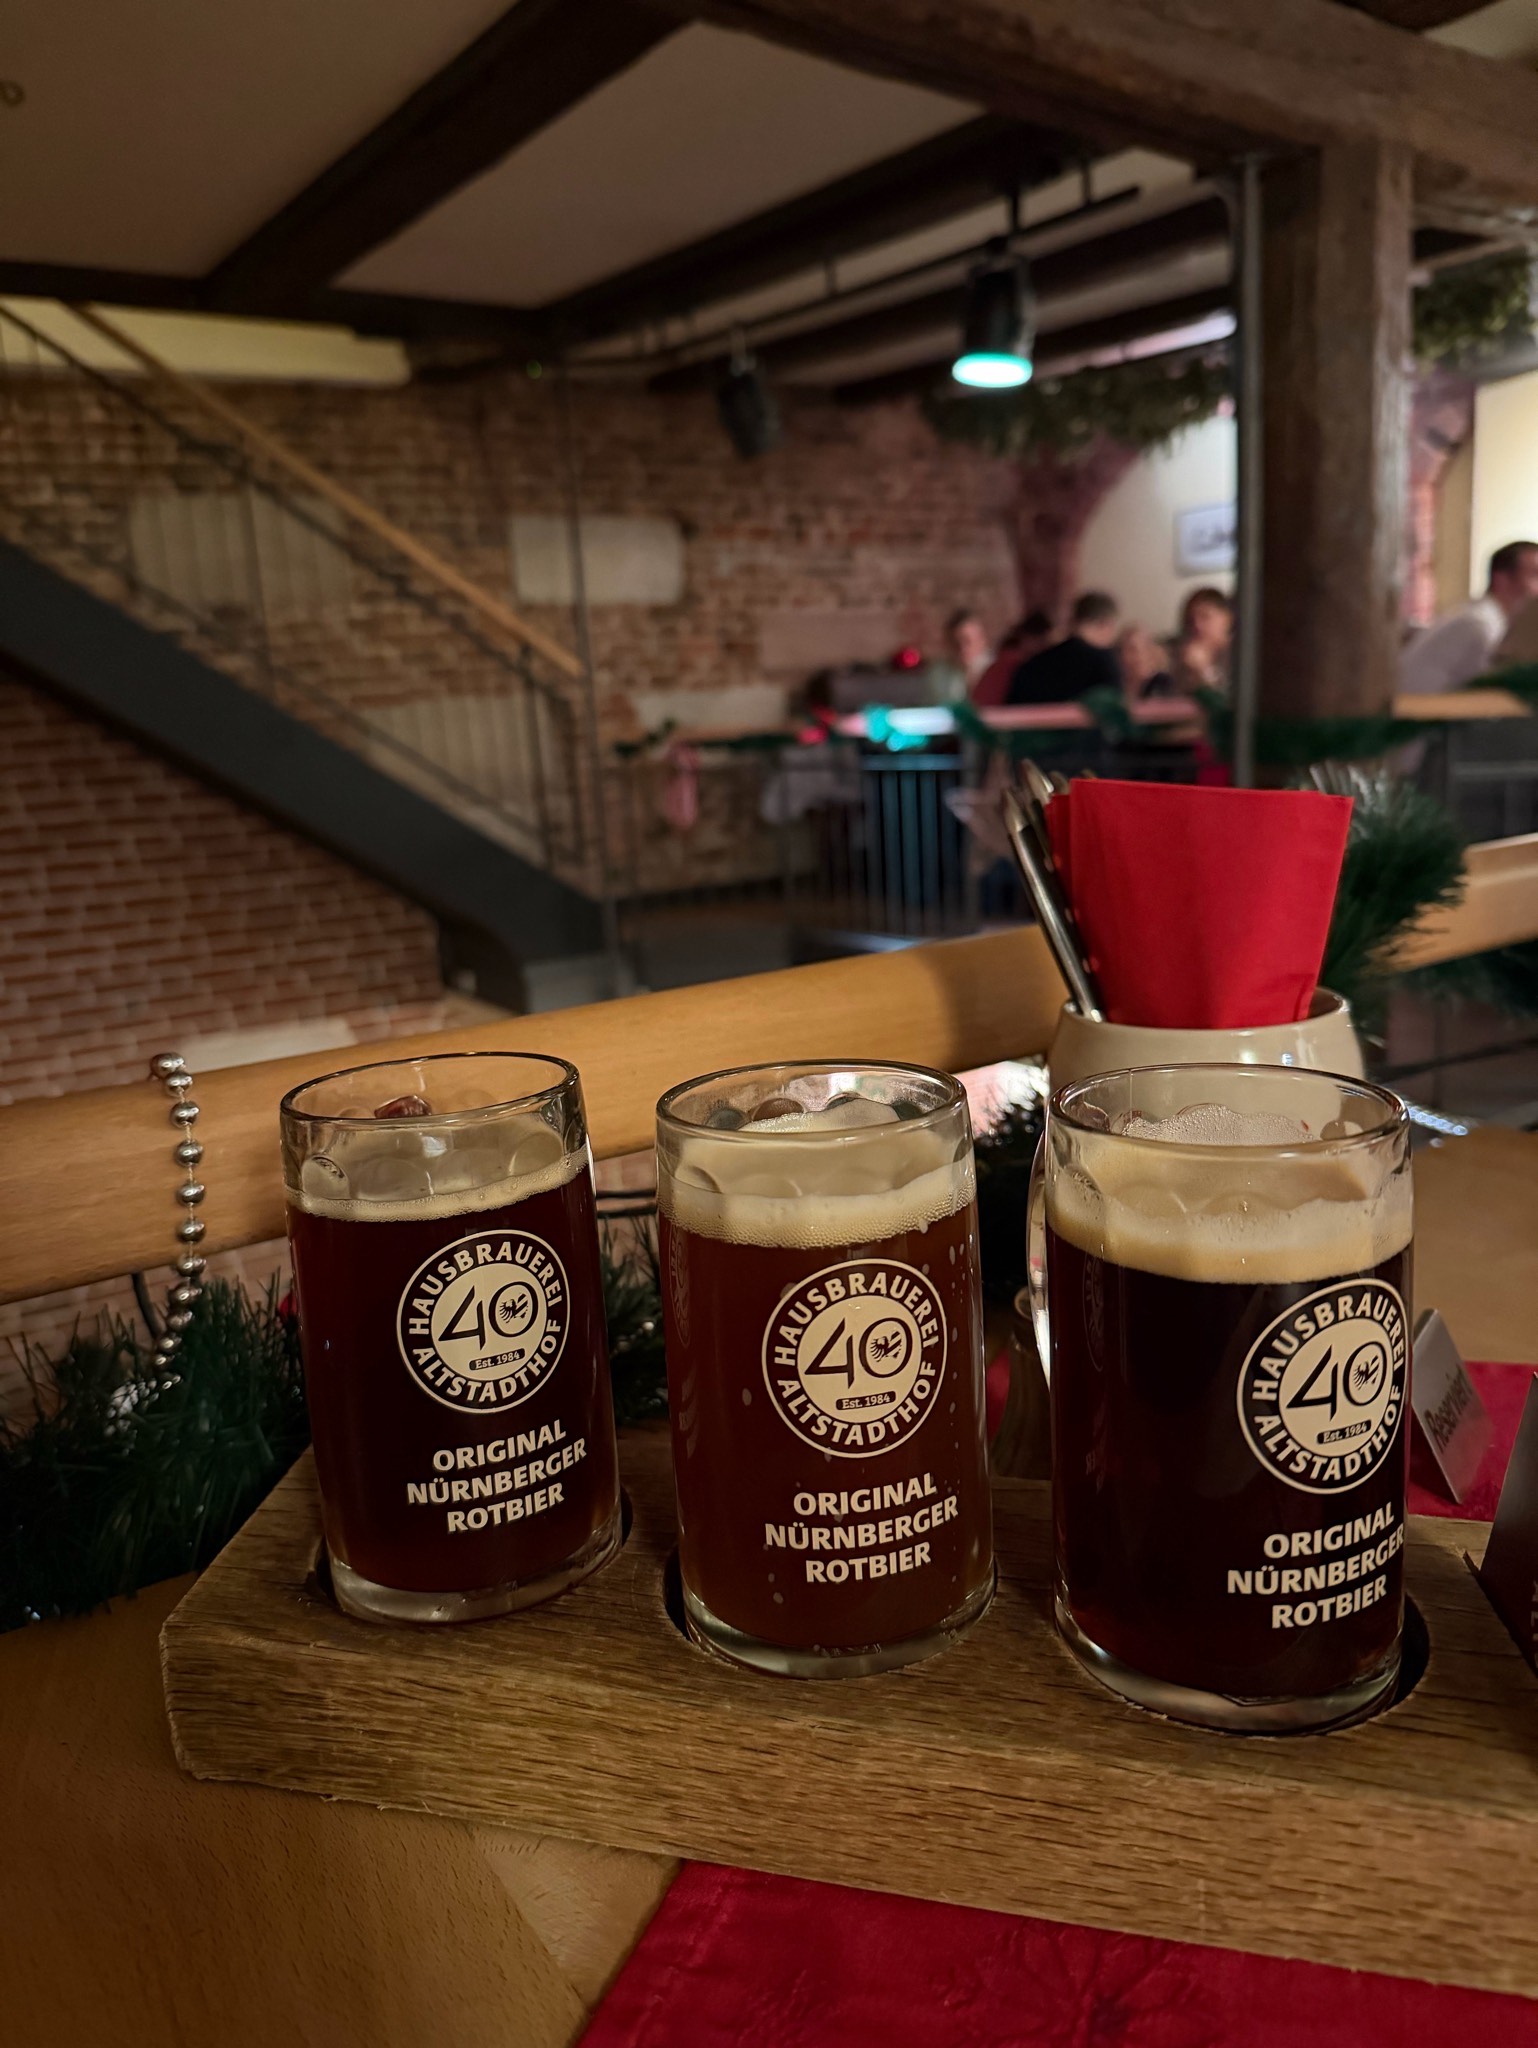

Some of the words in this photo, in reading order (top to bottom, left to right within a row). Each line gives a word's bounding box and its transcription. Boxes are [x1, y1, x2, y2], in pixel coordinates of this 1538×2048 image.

[409, 1241, 562, 1334] HAUSBRAUEREI
[438, 1281, 539, 1351] 40
[774, 1272, 939, 1366] HAUSBRAUEREI
[413, 1318, 561, 1403] ALTSTADTHOF
[475, 1358, 494, 1370] Est.
[496, 1350, 520, 1365] 1984
[804, 1317, 913, 1389] 40
[1252, 1292, 1405, 1400] HAUSBRAUEREI
[777, 1361, 936, 1446] ALTSTADTHOF
[841, 1398, 861, 1409] Est.
[864, 1393, 890, 1406] 1984
[1286, 1341, 1388, 1422] 40
[432, 1419, 566, 1471] ORIGINAL
[1254, 1385, 1400, 1481] ALTSTADTHOF
[1322, 1430, 1343, 1443] Est.
[407, 1437, 587, 1505] NÜRNBERGER
[793, 1472, 937, 1517] ORIGINAL
[447, 1482, 564, 1533] ROTBIER
[764, 1494, 959, 1550] NÜRNBERGER
[1263, 1501, 1395, 1559] ORIGINAL
[805, 1541, 931, 1583] ROTBIER
[1272, 1574, 1387, 1629] ROTBIER
